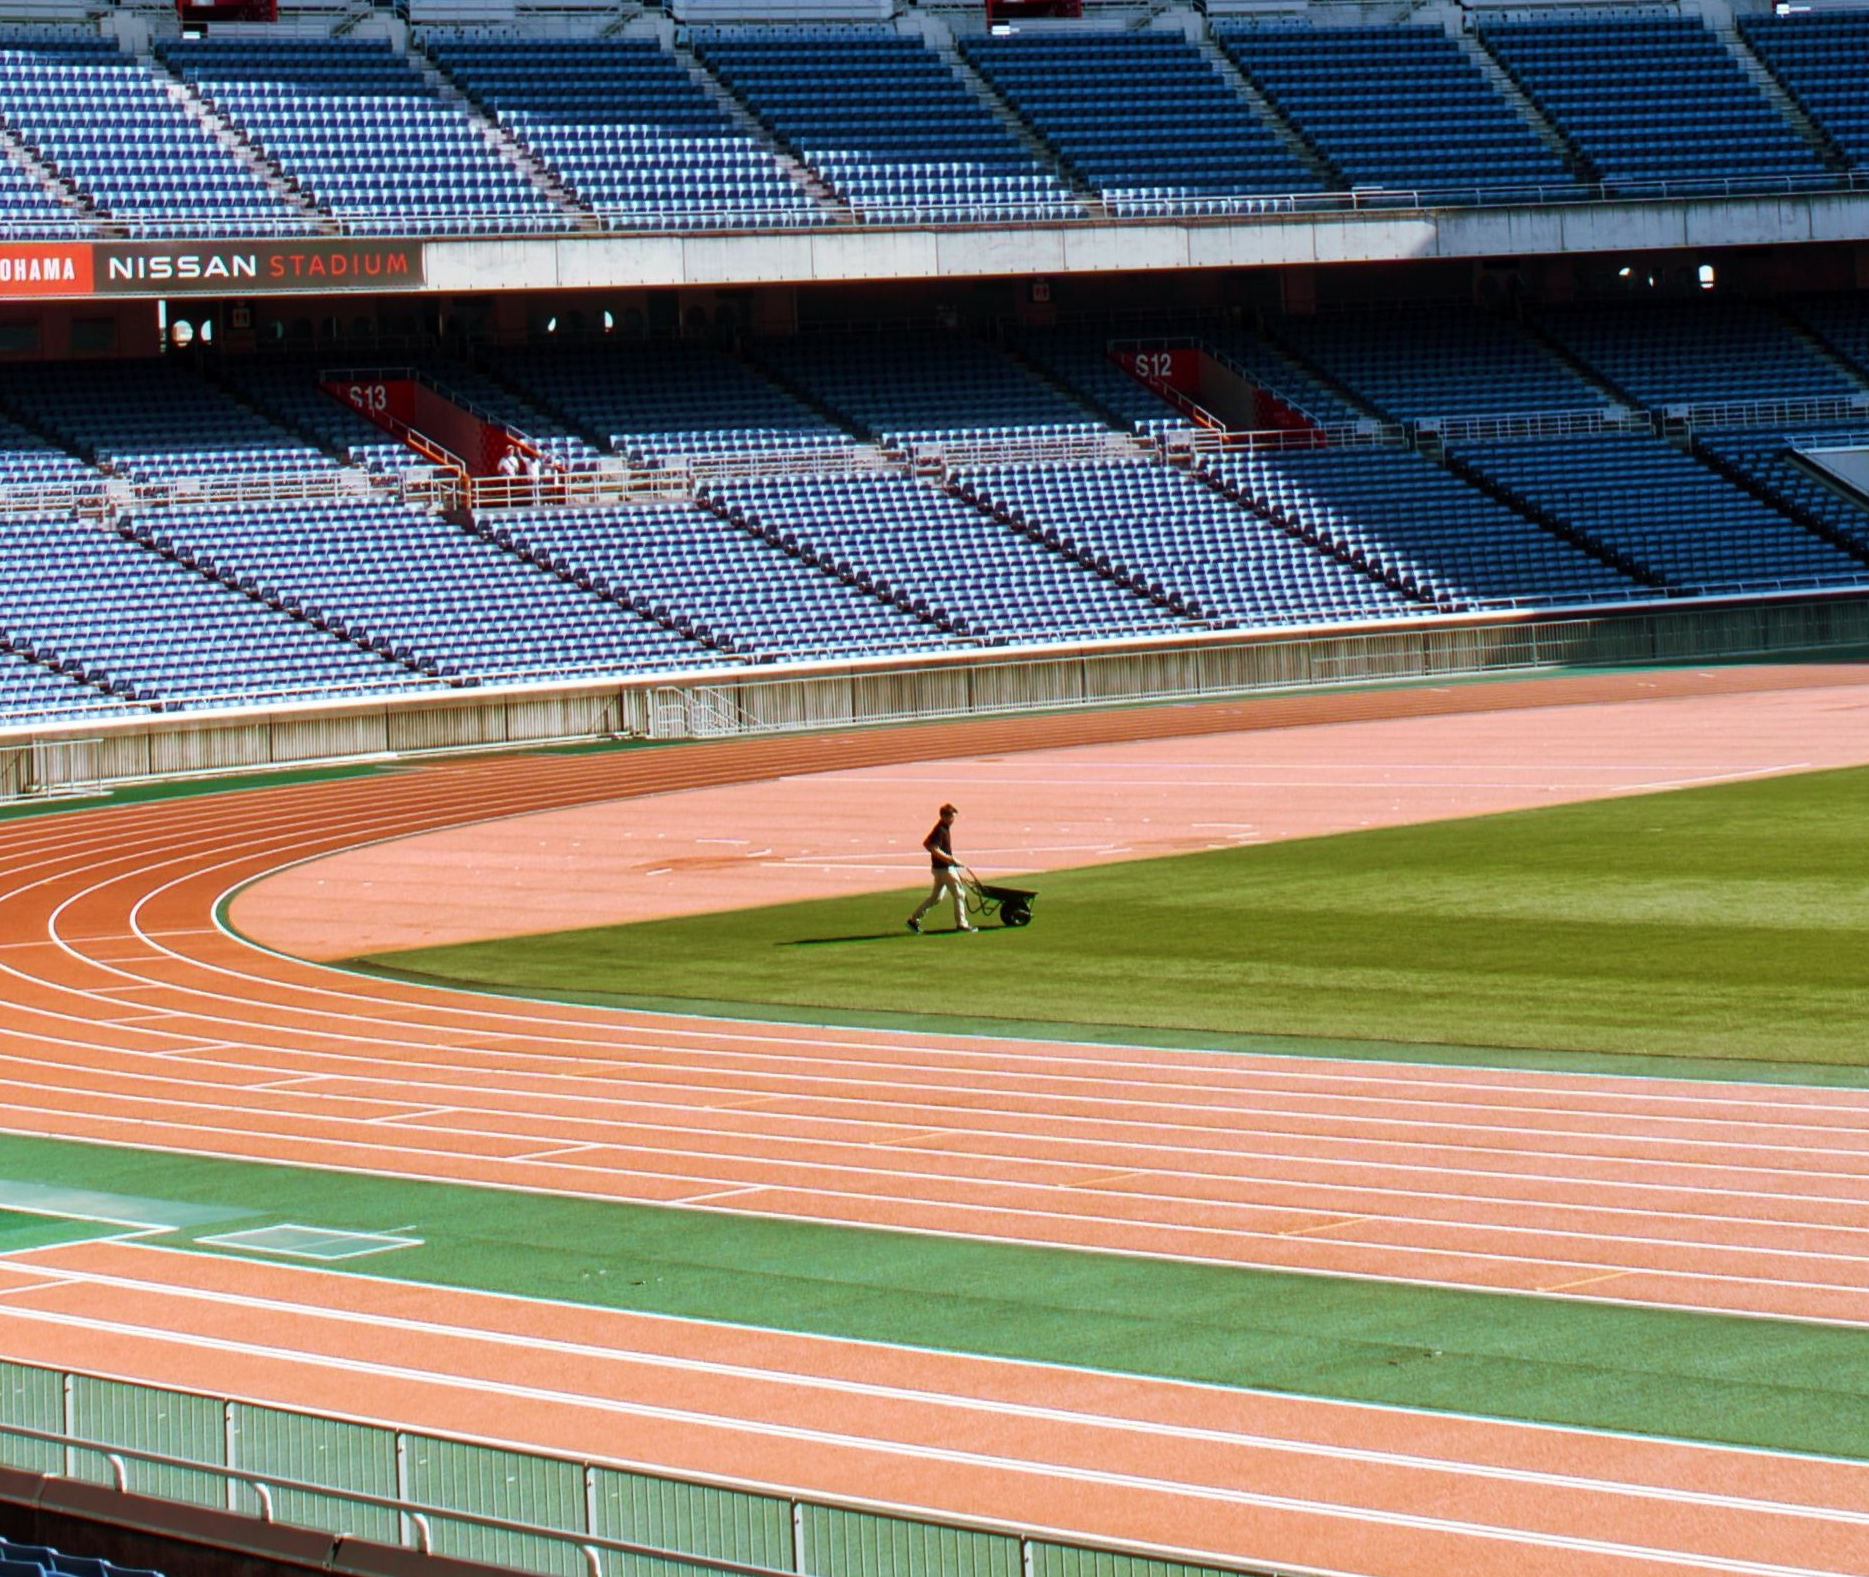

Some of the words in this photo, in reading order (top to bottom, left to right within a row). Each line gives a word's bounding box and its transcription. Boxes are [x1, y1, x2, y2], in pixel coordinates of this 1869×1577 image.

[108, 254, 257, 280] NISSAN
[268, 253, 409, 279] STADIUM
[1135, 353, 1172, 377] S12
[349, 385, 387, 411] S13
